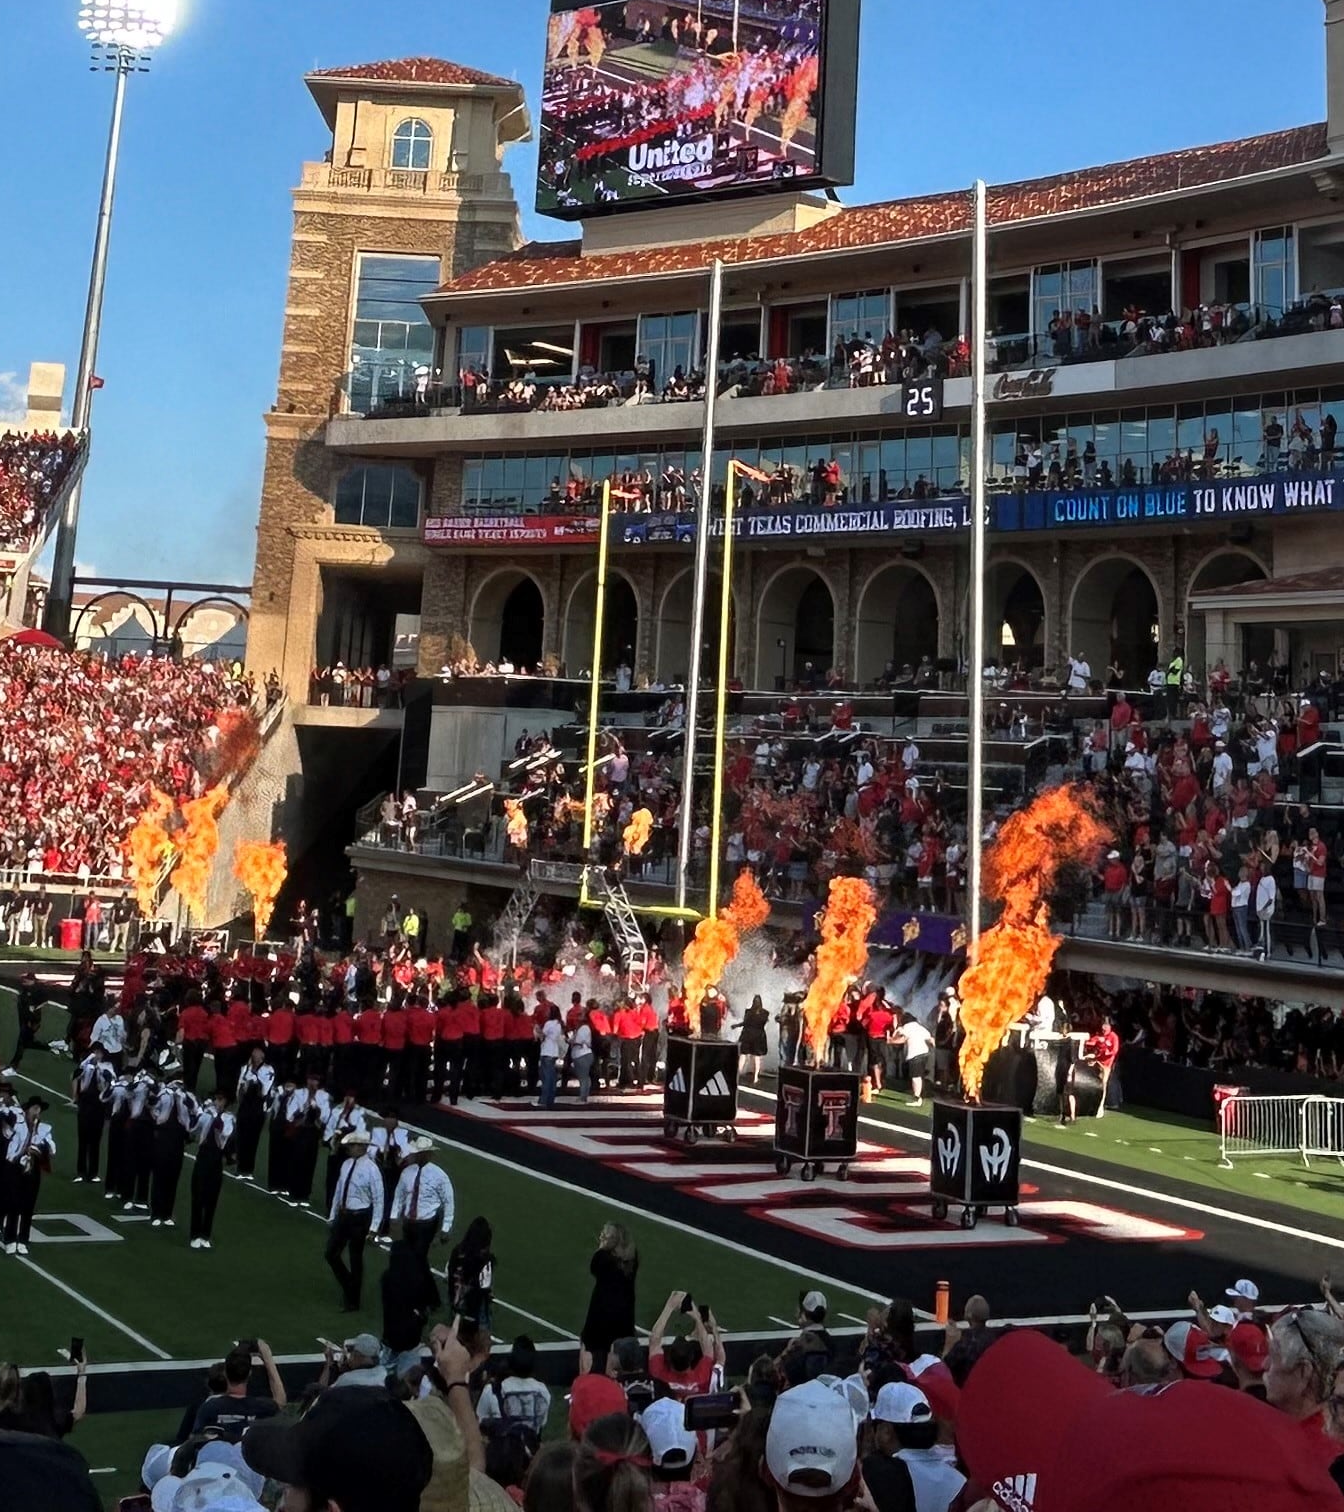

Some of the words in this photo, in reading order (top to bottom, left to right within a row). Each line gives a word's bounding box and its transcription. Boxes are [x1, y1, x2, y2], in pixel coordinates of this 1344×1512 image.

[628, 133, 713, 171] United
[906, 387, 934, 416] 25
[1055, 496, 1109, 522] COUNT
[1116, 494, 1139, 519] ON
[1144, 491, 1186, 518] BLUE
[1193, 489, 1216, 515] TO
[1222, 483, 1275, 513] KNOW
[1283, 478, 1336, 507] WHAT
[748, 514, 792, 536] TEXAS
[795, 509, 889, 535] COMMERCIAL
